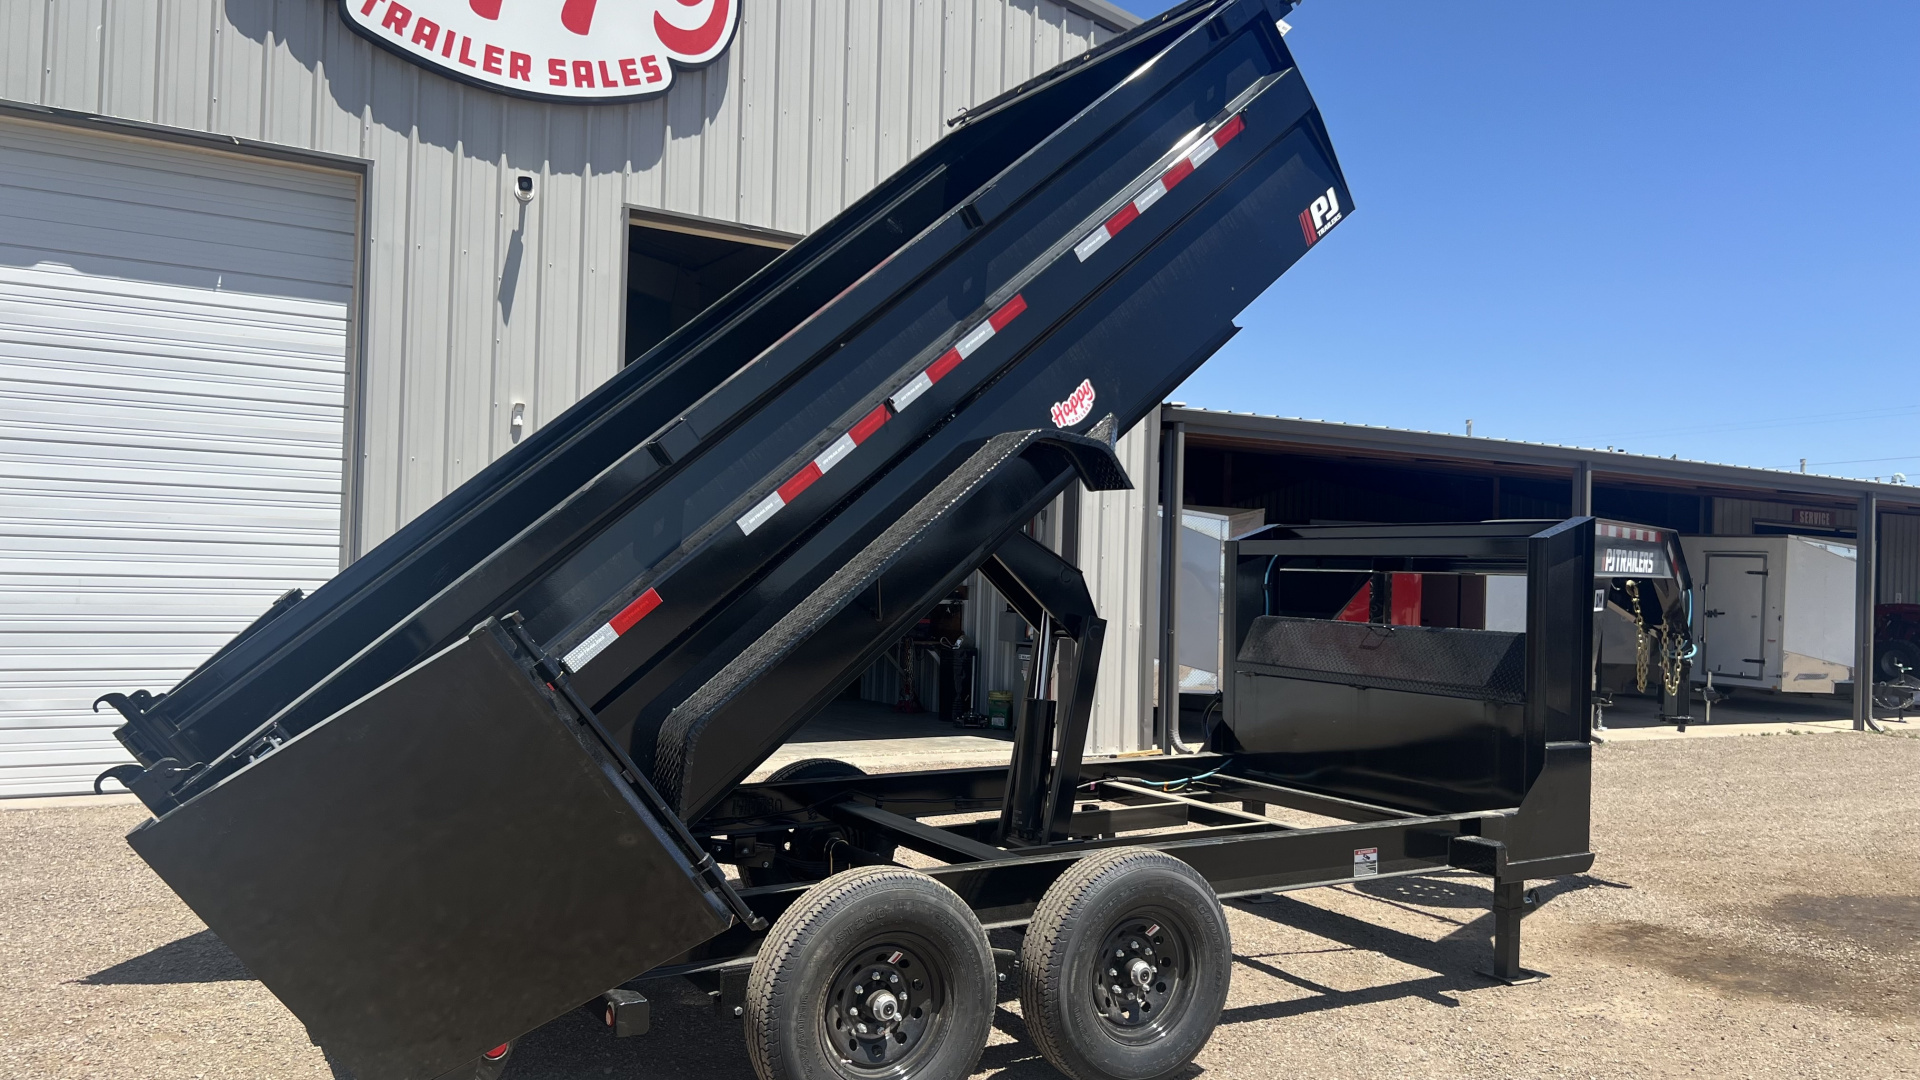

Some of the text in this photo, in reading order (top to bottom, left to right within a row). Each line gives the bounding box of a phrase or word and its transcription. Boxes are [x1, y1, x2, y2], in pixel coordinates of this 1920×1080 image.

[360, 0, 531, 82] TRAILER
[547, 55, 663, 89] SALES
[1310, 187, 1339, 230] PJ
[1053, 381, 1094, 426] Happy
[1799, 510, 1830, 526] SERVICE
